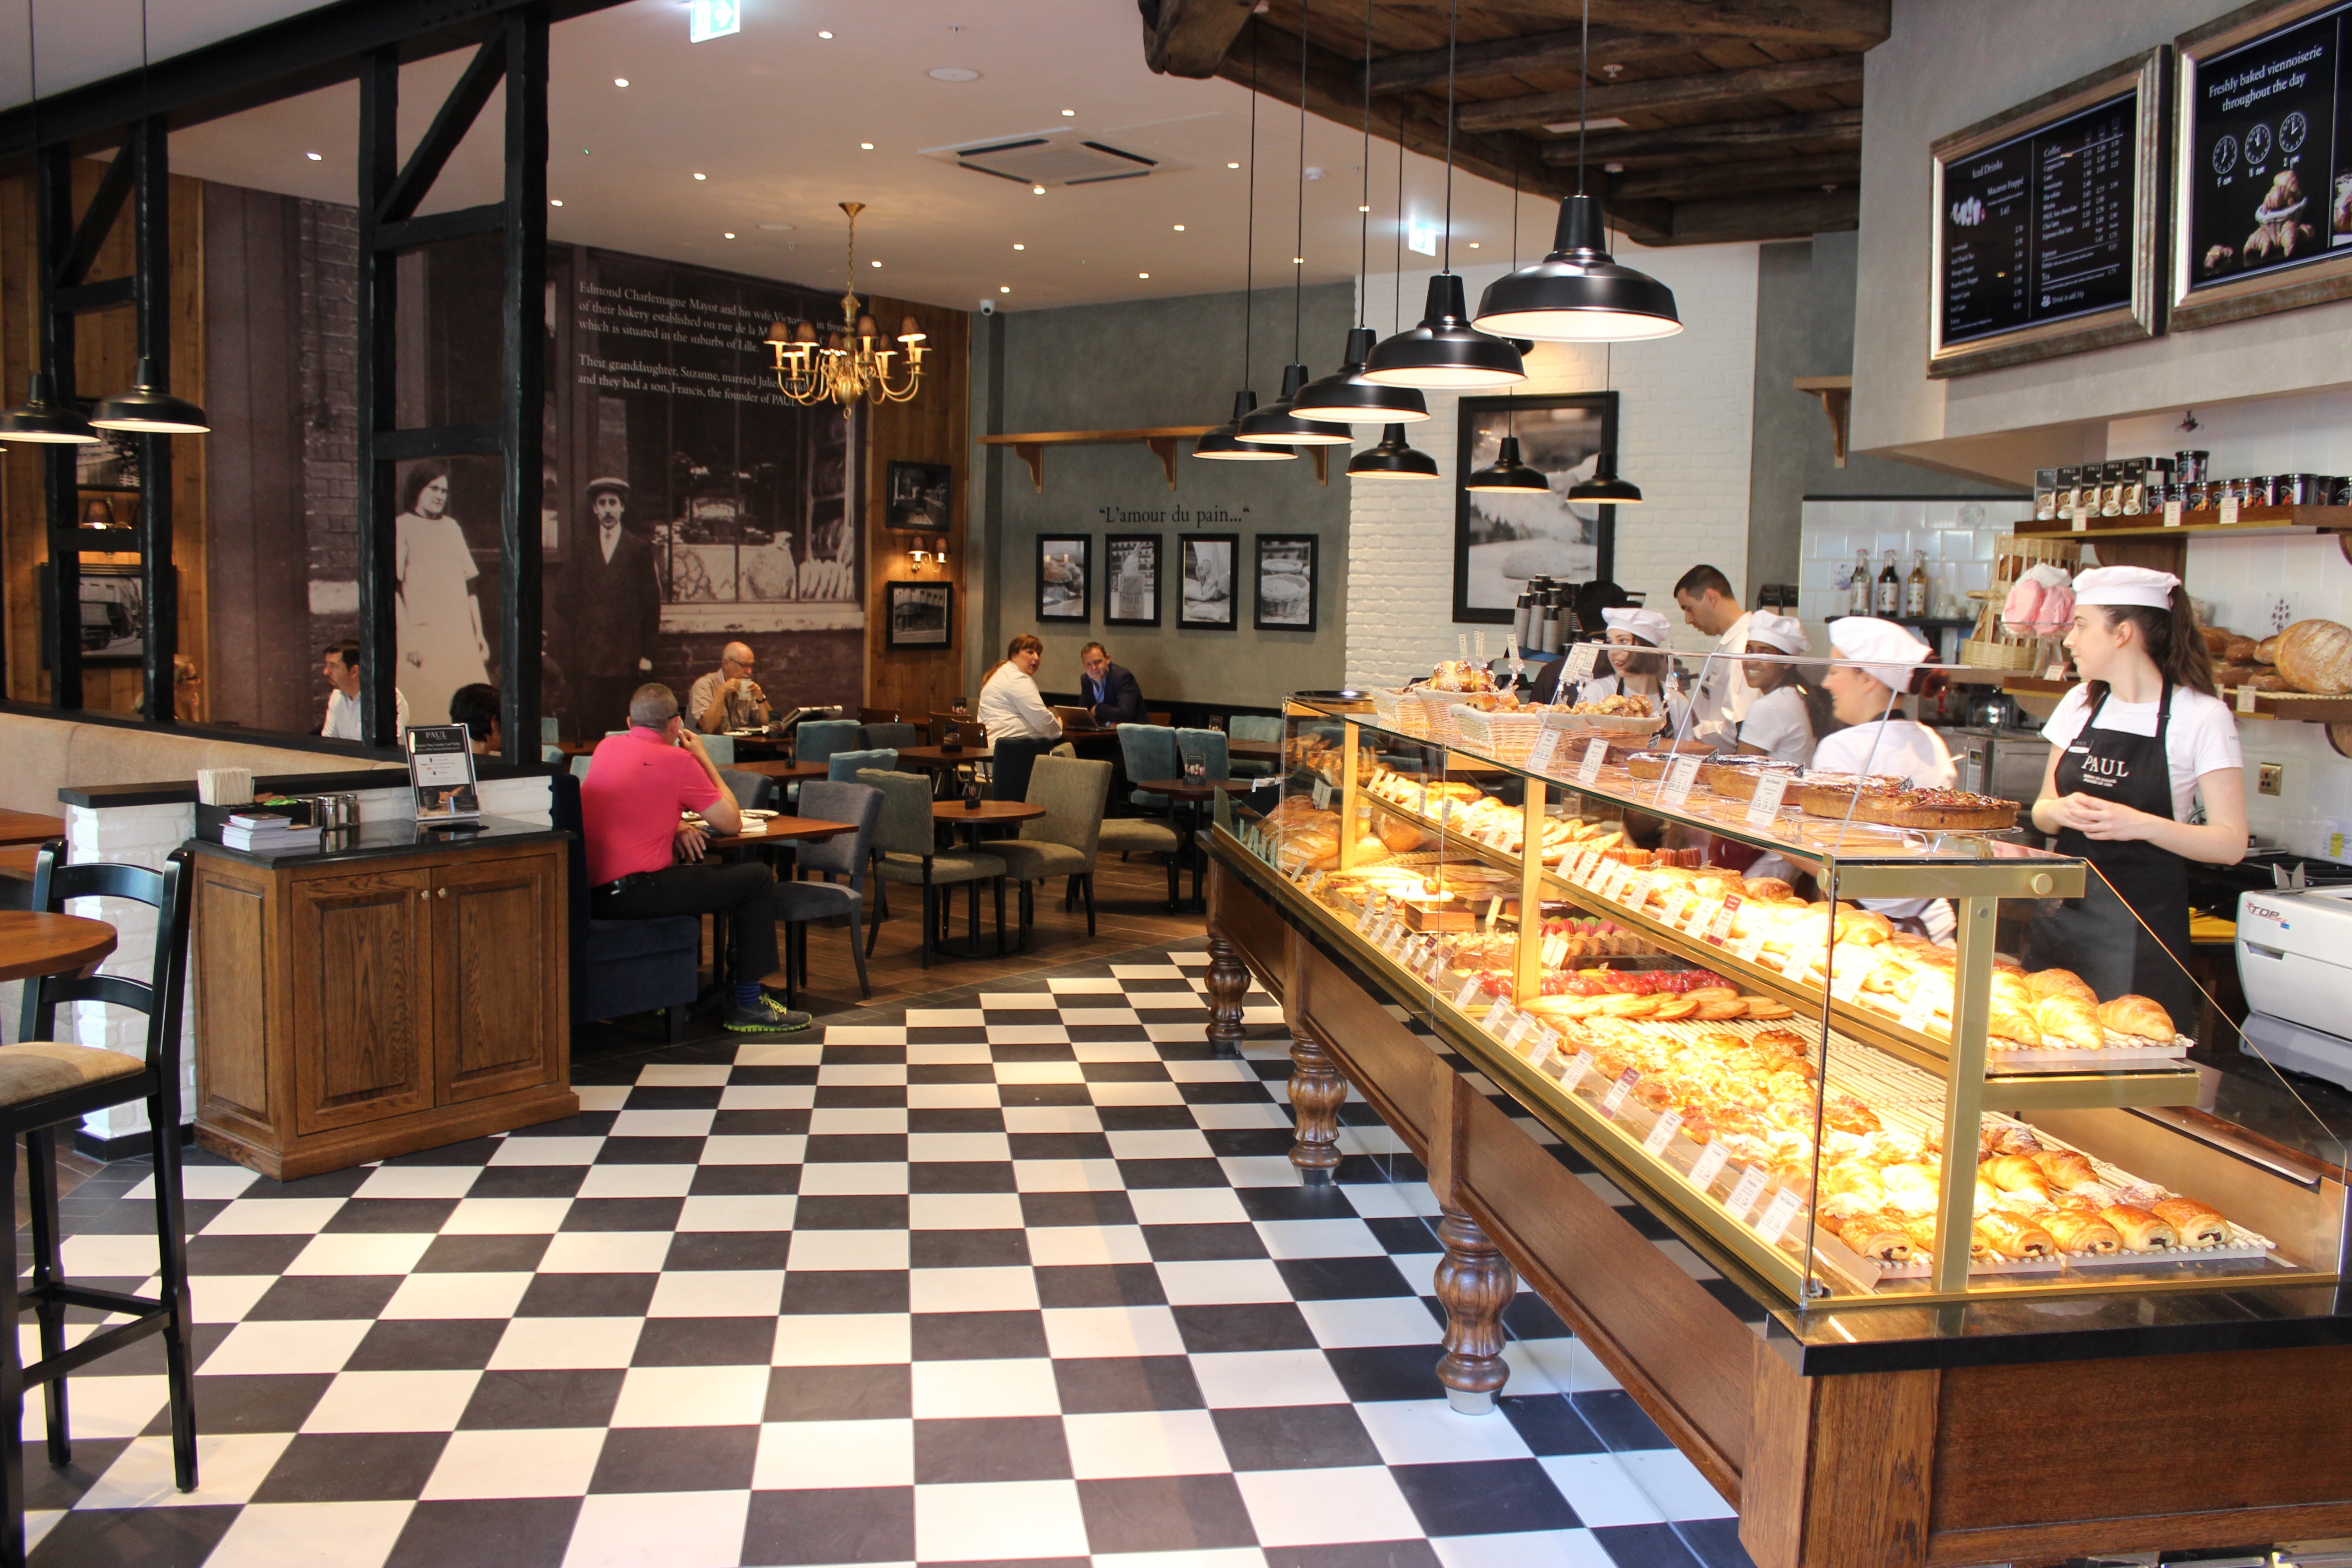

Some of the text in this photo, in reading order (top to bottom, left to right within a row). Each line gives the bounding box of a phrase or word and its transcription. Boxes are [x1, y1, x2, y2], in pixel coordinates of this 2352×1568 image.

[2209, 45, 2323, 98] Freshly baked viennoiserie
[2222, 72, 2306, 112] throughout the day
[1972, 159, 2004, 179] Iced Drinks
[578, 299, 756, 335] of their bakery established on rue de la
[579, 280, 622, 298] Edmond
[624, 288, 687, 309] Charlemagne
[689, 298, 718, 314] Mayot
[720, 304, 736, 316] and
[738, 305, 751, 318] his
[827, 320, 845, 333] fron
[578, 318, 760, 353] which is situated in the suburbs of Lille.
[578, 353, 607, 369] Their
[608, 360, 679, 378] granddaughter,
[680, 366, 720, 382] Suzanne,
[721, 374, 757, 386] married
[578, 373, 597, 385] and
[598, 374, 621, 391] they
[622, 377, 641, 390] had
[642, 382, 648, 391] a
[650, 383, 670, 394] son,
[671, 382, 706, 398] Francis,
[707, 386, 722, 399] the
[724, 387, 759, 403] founder
[760, 393, 771, 404] of
[1171, 504, 1190, 522] du
[426, 731, 447, 739] PAUL
[2080, 755, 2130, 778] PAUL
[2251, 905, 2280, 917] TOP
